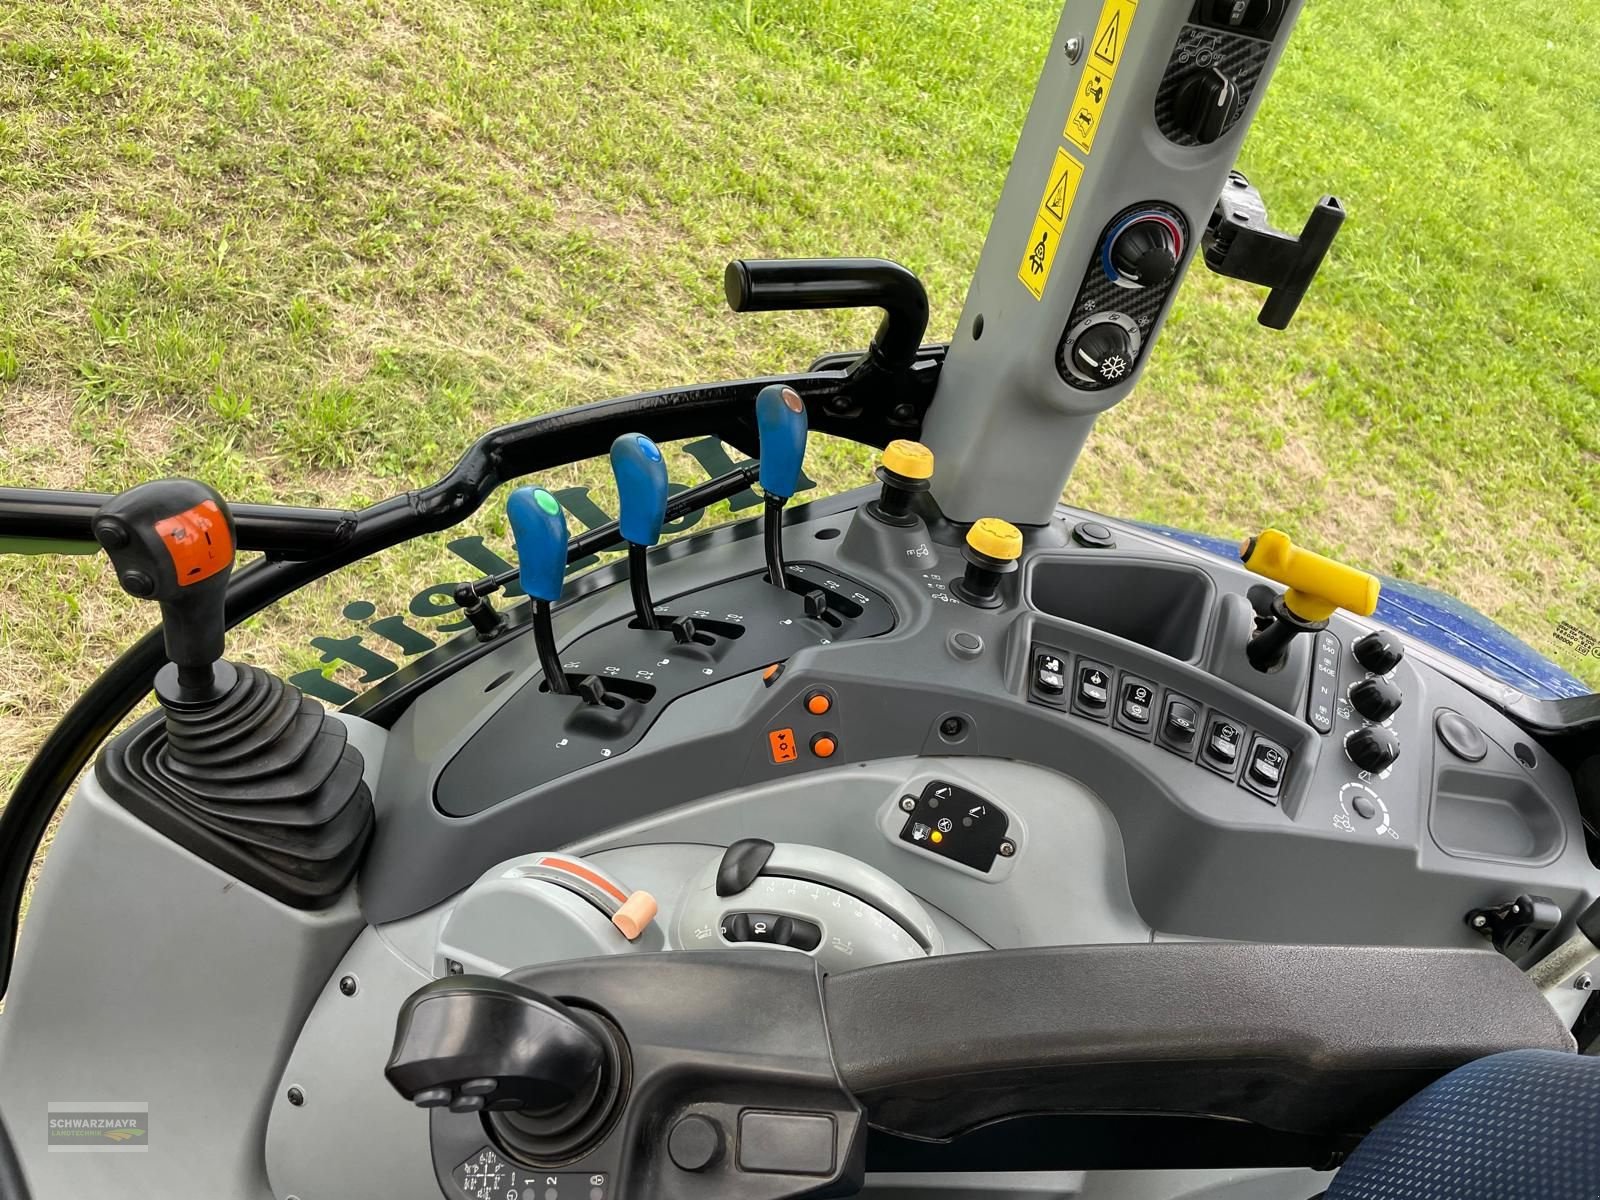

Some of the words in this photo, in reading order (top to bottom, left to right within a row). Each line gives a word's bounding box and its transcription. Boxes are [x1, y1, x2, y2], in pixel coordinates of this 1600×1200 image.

[1322, 644, 1335, 655] 540
[1318, 663, 1336, 677] 540E
[1321, 686, 1328, 695] N
[1315, 713, 1330, 725] 1000
[755, 922, 767, 934] 10
[547, 1176, 557, 1185] 2
